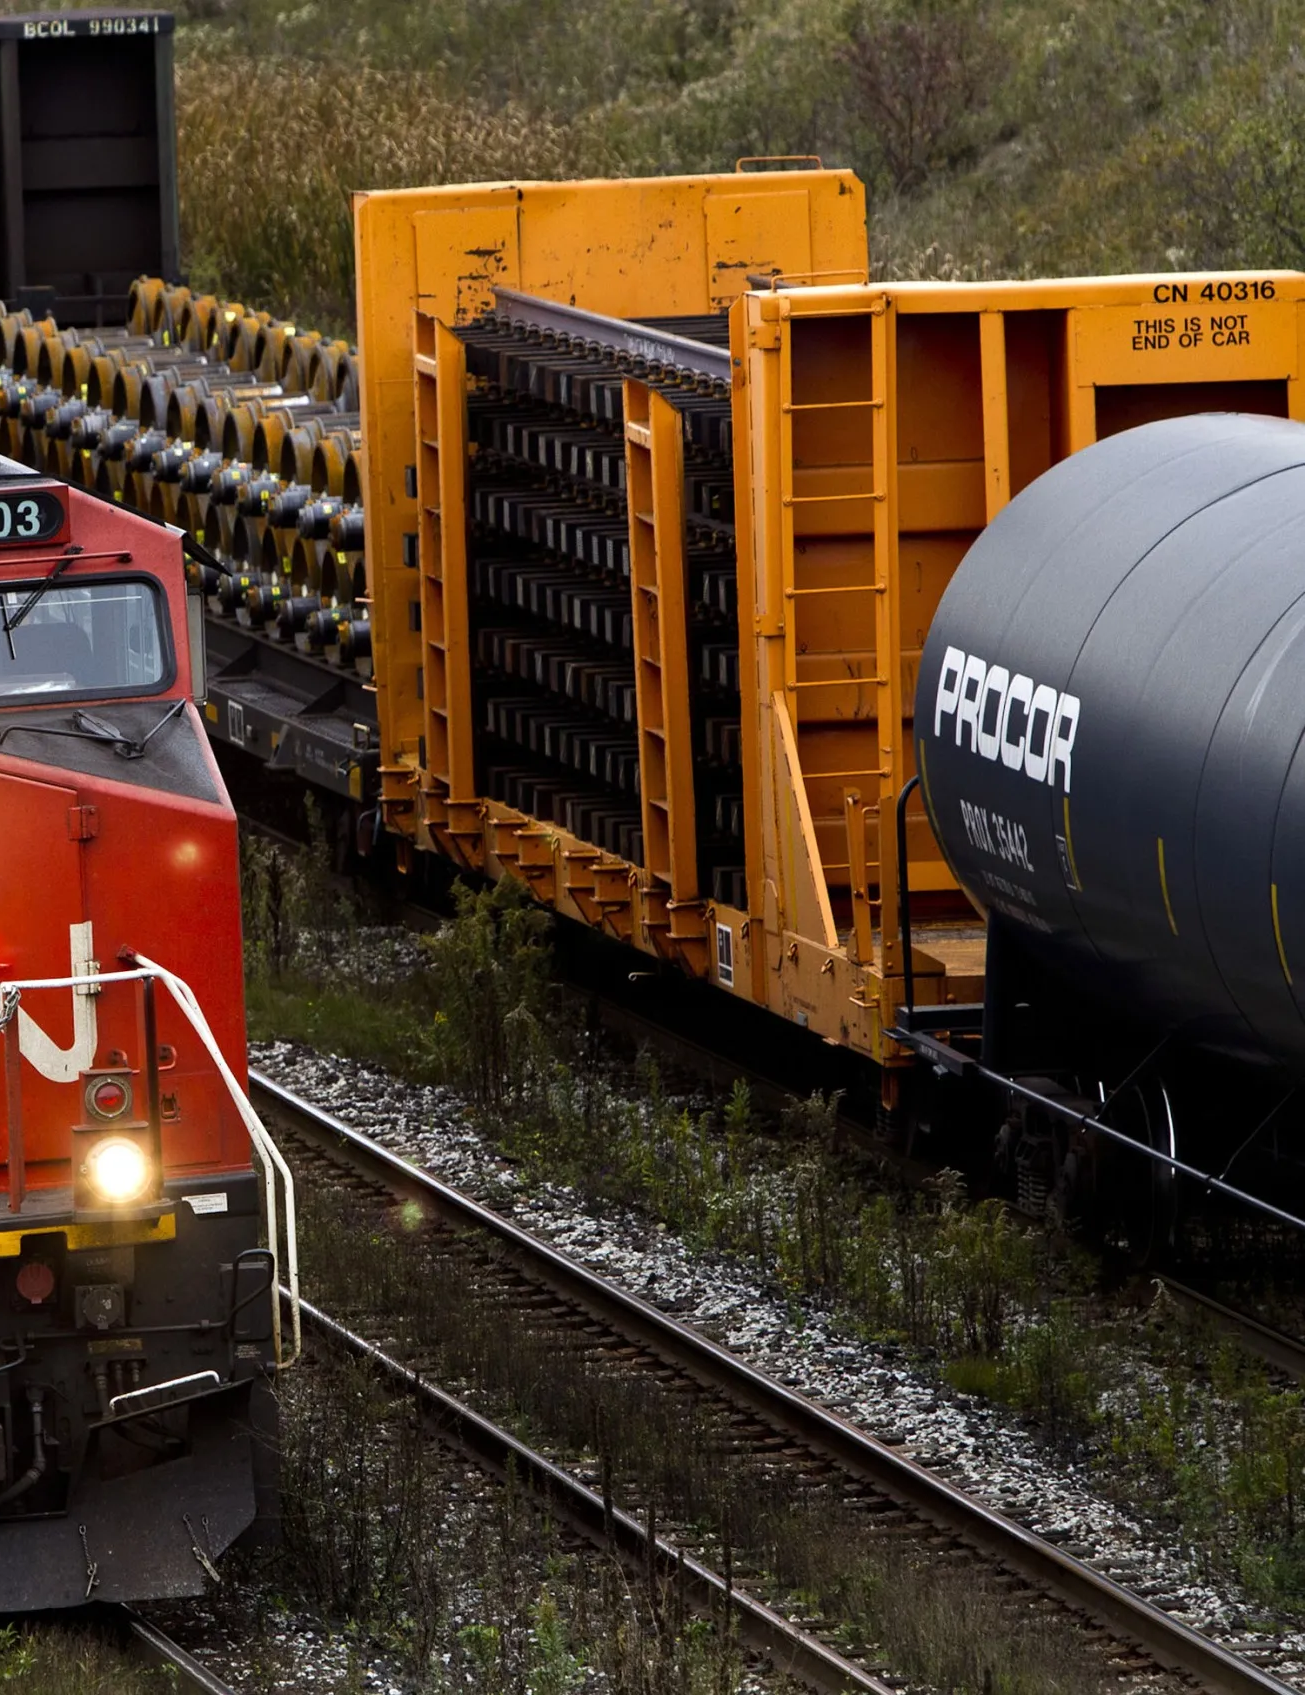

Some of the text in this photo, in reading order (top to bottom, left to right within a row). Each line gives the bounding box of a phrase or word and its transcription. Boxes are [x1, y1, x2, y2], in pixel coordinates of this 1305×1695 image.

[23, 16, 160, 39] BCOL 990341
[1153, 279, 1276, 304] CN 40316
[1133, 314, 1248, 335] THIS IS NOT
[1132, 330, 1250, 350] END OF CAR
[934, 645, 1081, 793] PROCOR
[959, 799, 997, 855] PROX
[992, 812, 1035, 873] 35442
